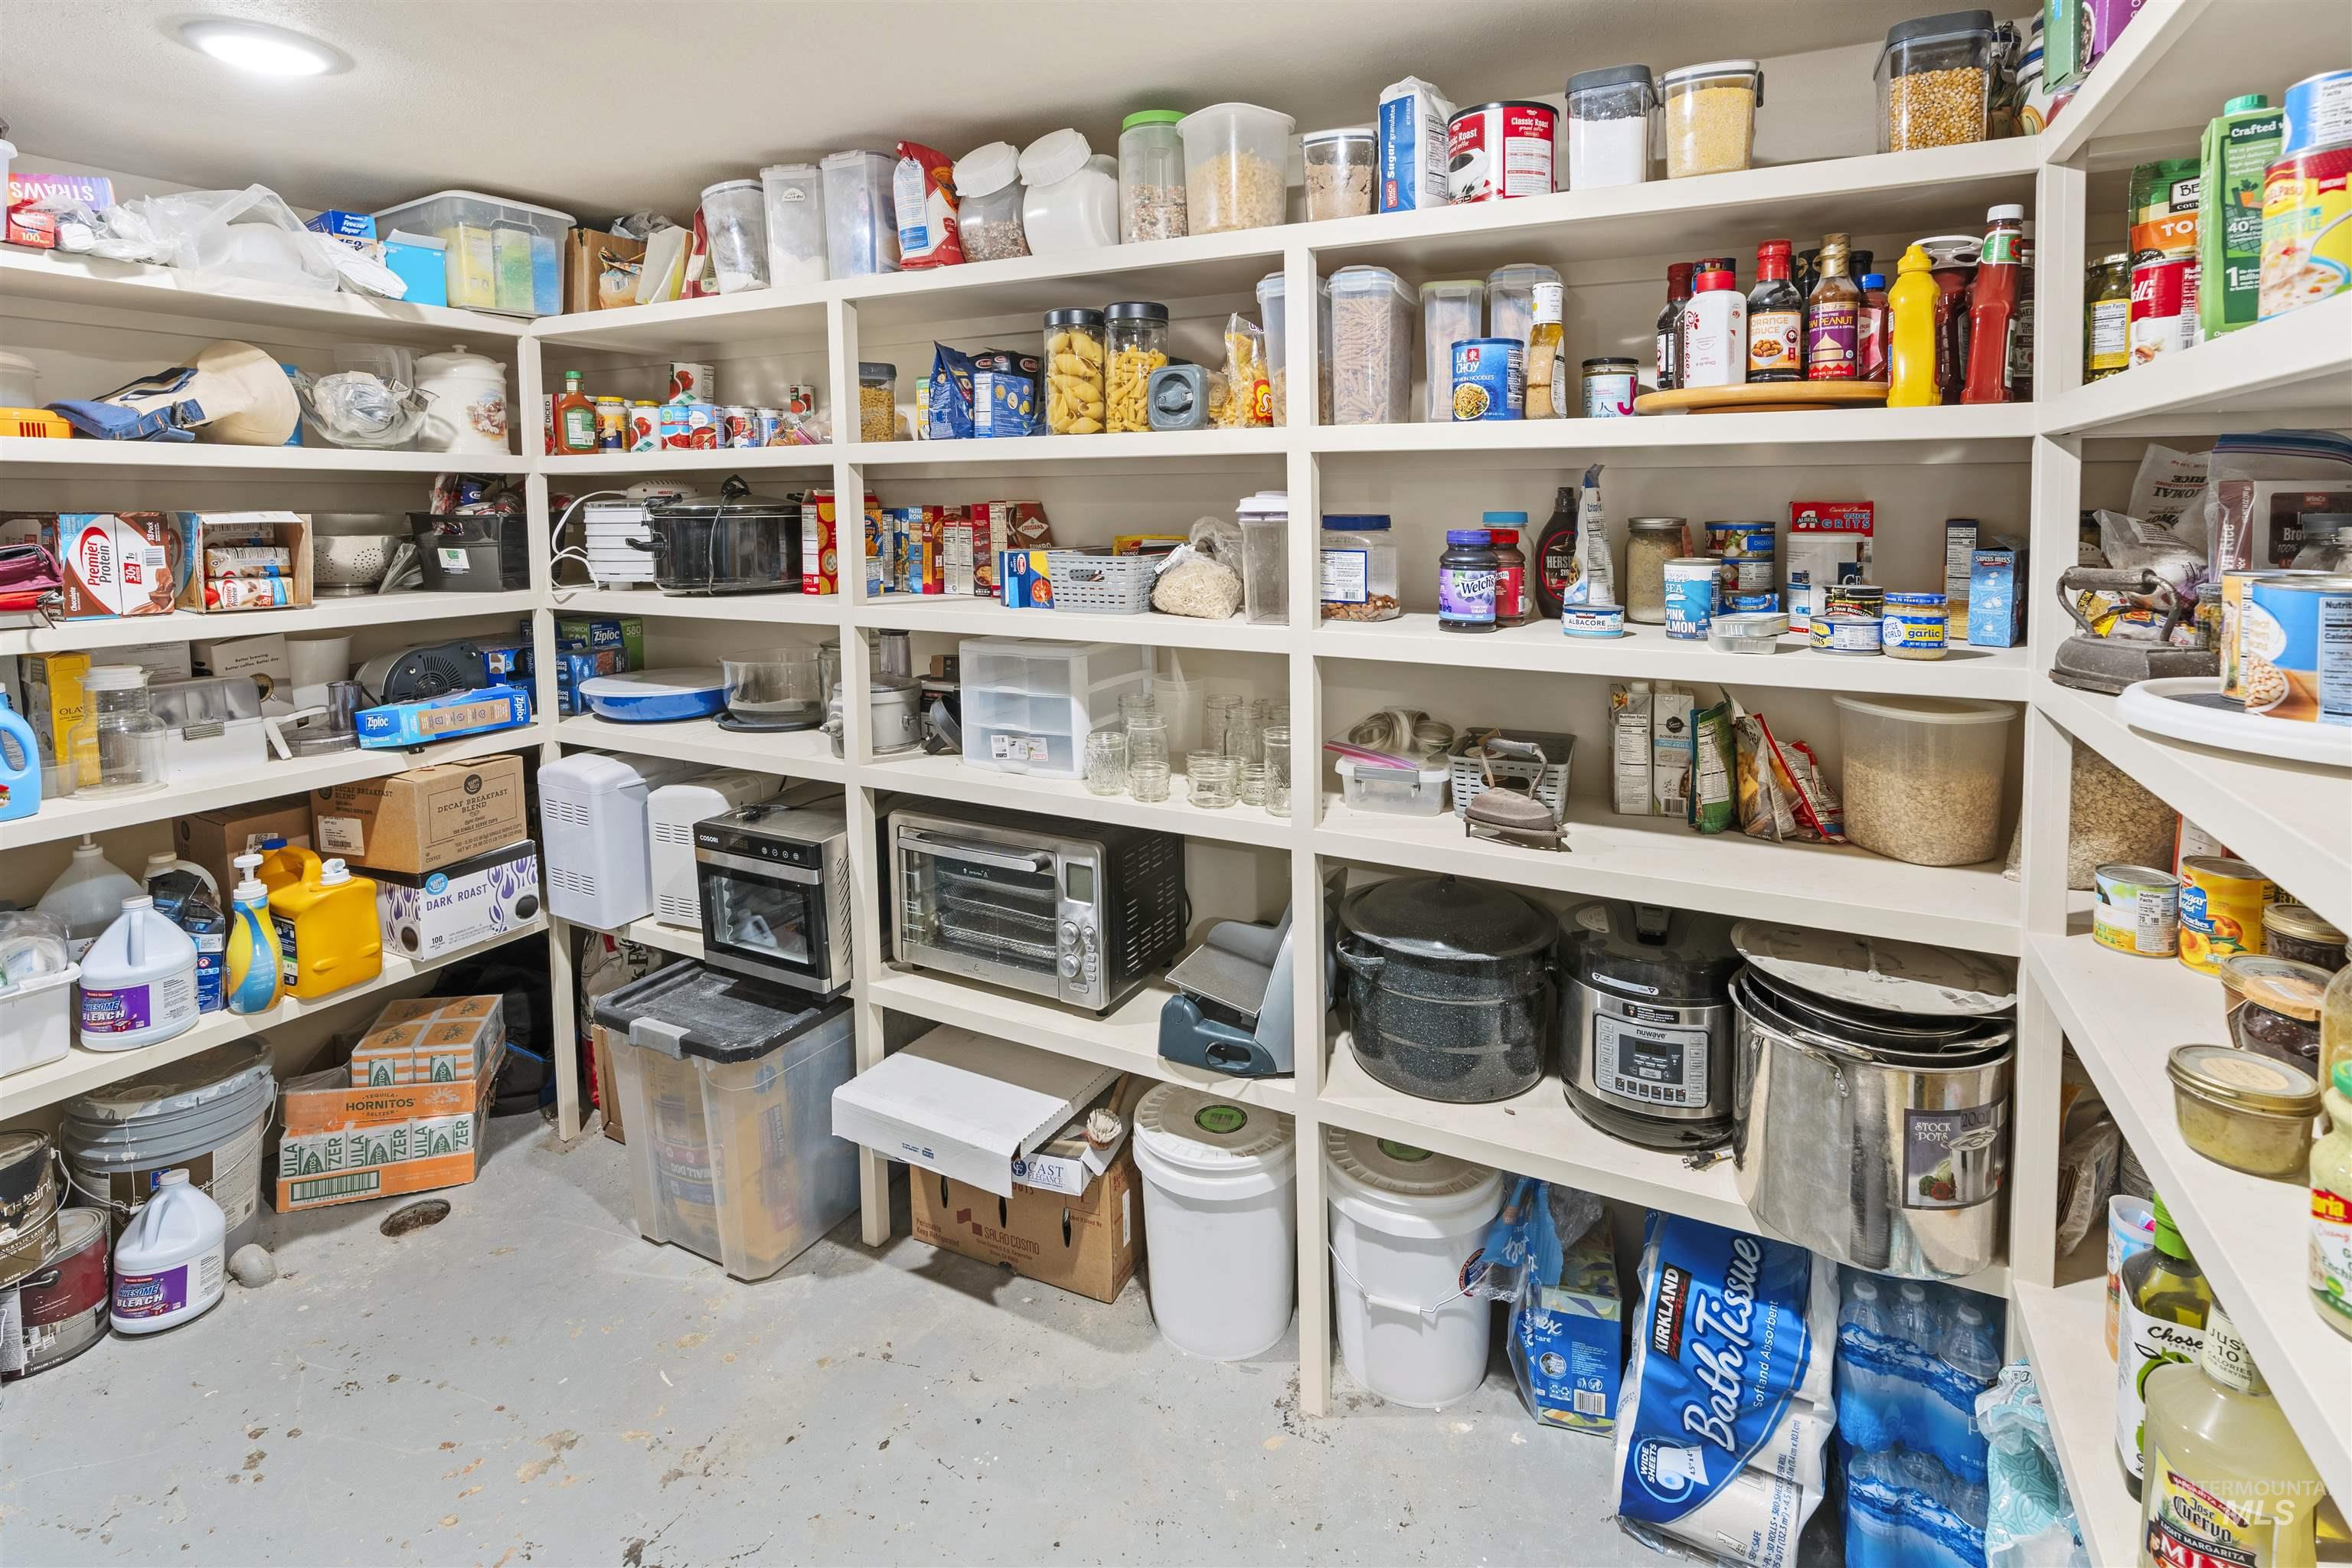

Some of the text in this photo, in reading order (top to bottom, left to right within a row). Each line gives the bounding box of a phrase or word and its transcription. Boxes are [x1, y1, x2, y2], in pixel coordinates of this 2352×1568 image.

[1511, 117, 1549, 128] Classic Roast
[2231, 121, 2277, 137] Crafted
[1459, 128, 1478, 140] Roast
[1387, 142, 1396, 178] Sugar
[9, 181, 94, 201] STRAWS
[341, 226, 361, 235] Paper
[343, 220, 368, 229] Freezer
[2228, 220, 2249, 234] 40
[2226, 266, 2239, 287] 1
[1751, 316, 1789, 327] ORANGE
[1820, 316, 1853, 326] PEANUT
[1751, 325, 1780, 336] SAUCE
[1456, 352, 1466, 363] LA
[1456, 361, 1479, 374] CHOY
[1021, 522, 1045, 531] LOUISIANA
[1821, 518, 1870, 530] GRITS
[87, 541, 100, 586] Premier
[99, 545, 112, 583] Protein
[126, 565, 136, 583] 30g
[1461, 577, 1494, 594] Welch's
[1666, 584, 1684, 593] SEA
[1568, 618, 1606, 626] ALBACORE
[1666, 608, 1685, 621] PINK
[593, 629, 620, 644] Ziploc
[626, 626, 642, 636] 580
[1884, 630, 1902, 639] WORLD
[1908, 629, 1940, 639] garlic
[1811, 635, 1825, 645] LAMS
[514, 694, 525, 721] Ziploc
[367, 715, 389, 730] Ziploc
[358, 787, 393, 797] BREAKFAST
[437, 789, 508, 813] DECAF BREAKFAST
[461, 801, 487, 814] BLEND
[475, 820, 488, 828] SERVE
[700, 835, 718, 843] COSORI
[426, 854, 442, 864] COFFEE
[426, 884, 488, 911] DARK ROAST
[431, 935, 443, 944] 100
[83, 1010, 126, 1022] BLEACH
[1636, 1028, 1666, 1039] nuwave
[345, 1098, 414, 1112] HORNITOS
[1915, 1122, 1952, 1132] STOCK
[1917, 1132, 1949, 1141] POTS
[1027, 1161, 1064, 1178] CAST
[1027, 1171, 1063, 1184] ELEGANCE
[916, 1217, 942, 1233] Perishable
[1, 1225, 47, 1255] ACRYLIC LATEX
[916, 1226, 960, 1247] Keep Refrigerated
[984, 1227, 1040, 1255] SALAD COSMO
[4, 1272, 21, 1282] SATIN
[119, 1284, 160, 1298] AWESOME
[117, 1292, 164, 1308] BLEACH
[1654, 1268, 1680, 1354] KIRKLAND
[1668, 1277, 1689, 1361] Signature
[1684, 1236, 1760, 1453] Bath Tissue
[2148, 1326, 2203, 1350] Chose
[1753, 1299, 1779, 1408] Soft and Absorbent
[2218, 1345, 2239, 1363] 10
[2208, 1350, 2252, 1377] CALORIES
[2220, 1364, 2253, 1382] SERVING
[1790, 1431, 1800, 1443] 10.1
[1640, 1446, 1649, 1475] WIDE
[1647, 1443, 1657, 1484] SHEETS
[2172, 1475, 2216, 1505] MARGARITA
[1766, 1453, 1787, 1553] 30 ROLLS 380 SHEETS PER ROLL
[2190, 1497, 2216, 1519] Jose
[2173, 1495, 2233, 1544] Cuervo
[1753, 1530, 1762, 1548] SAFE
[1778, 1524, 1788, 1547] (132.3
[2160, 1521, 2246, 1563] LIGHT MARGARITA
[1775, 1544, 1785, 1557] FT
